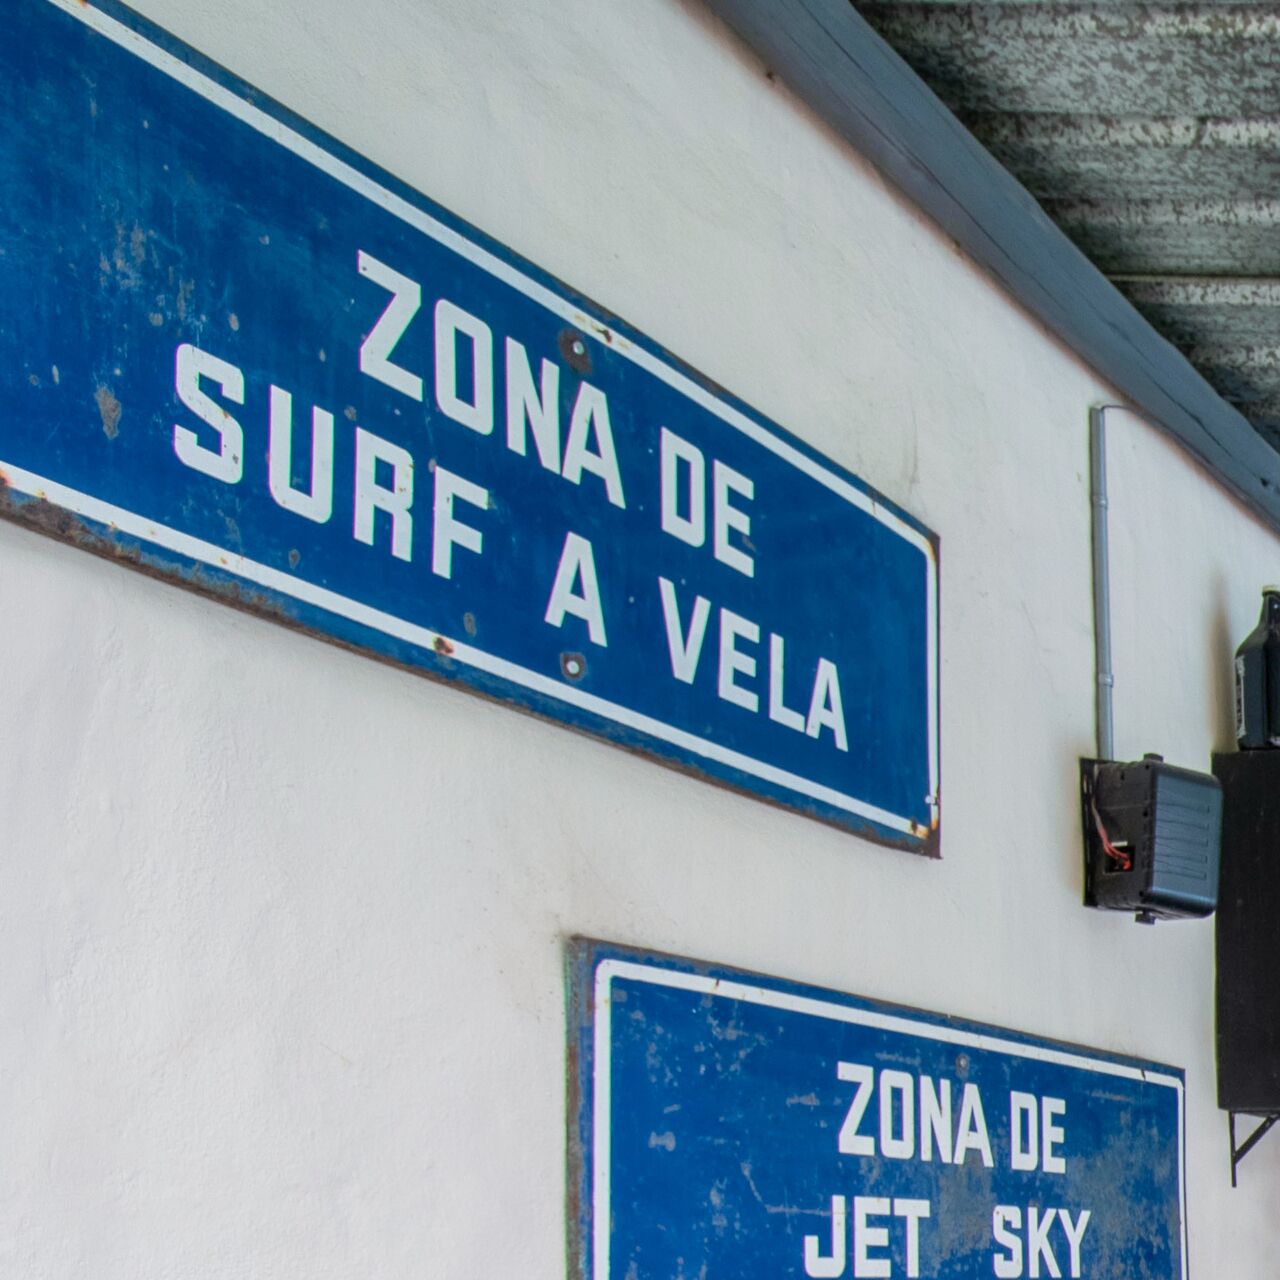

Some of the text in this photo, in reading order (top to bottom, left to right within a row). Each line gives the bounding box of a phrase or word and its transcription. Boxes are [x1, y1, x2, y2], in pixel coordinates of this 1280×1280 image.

[357, 249, 754, 578] ZONA DE
[173, 343, 849, 752] SURF A VELA
[836, 1061, 1067, 1174] ZONA DE
[803, 1194, 1092, 1280] JET SKY
